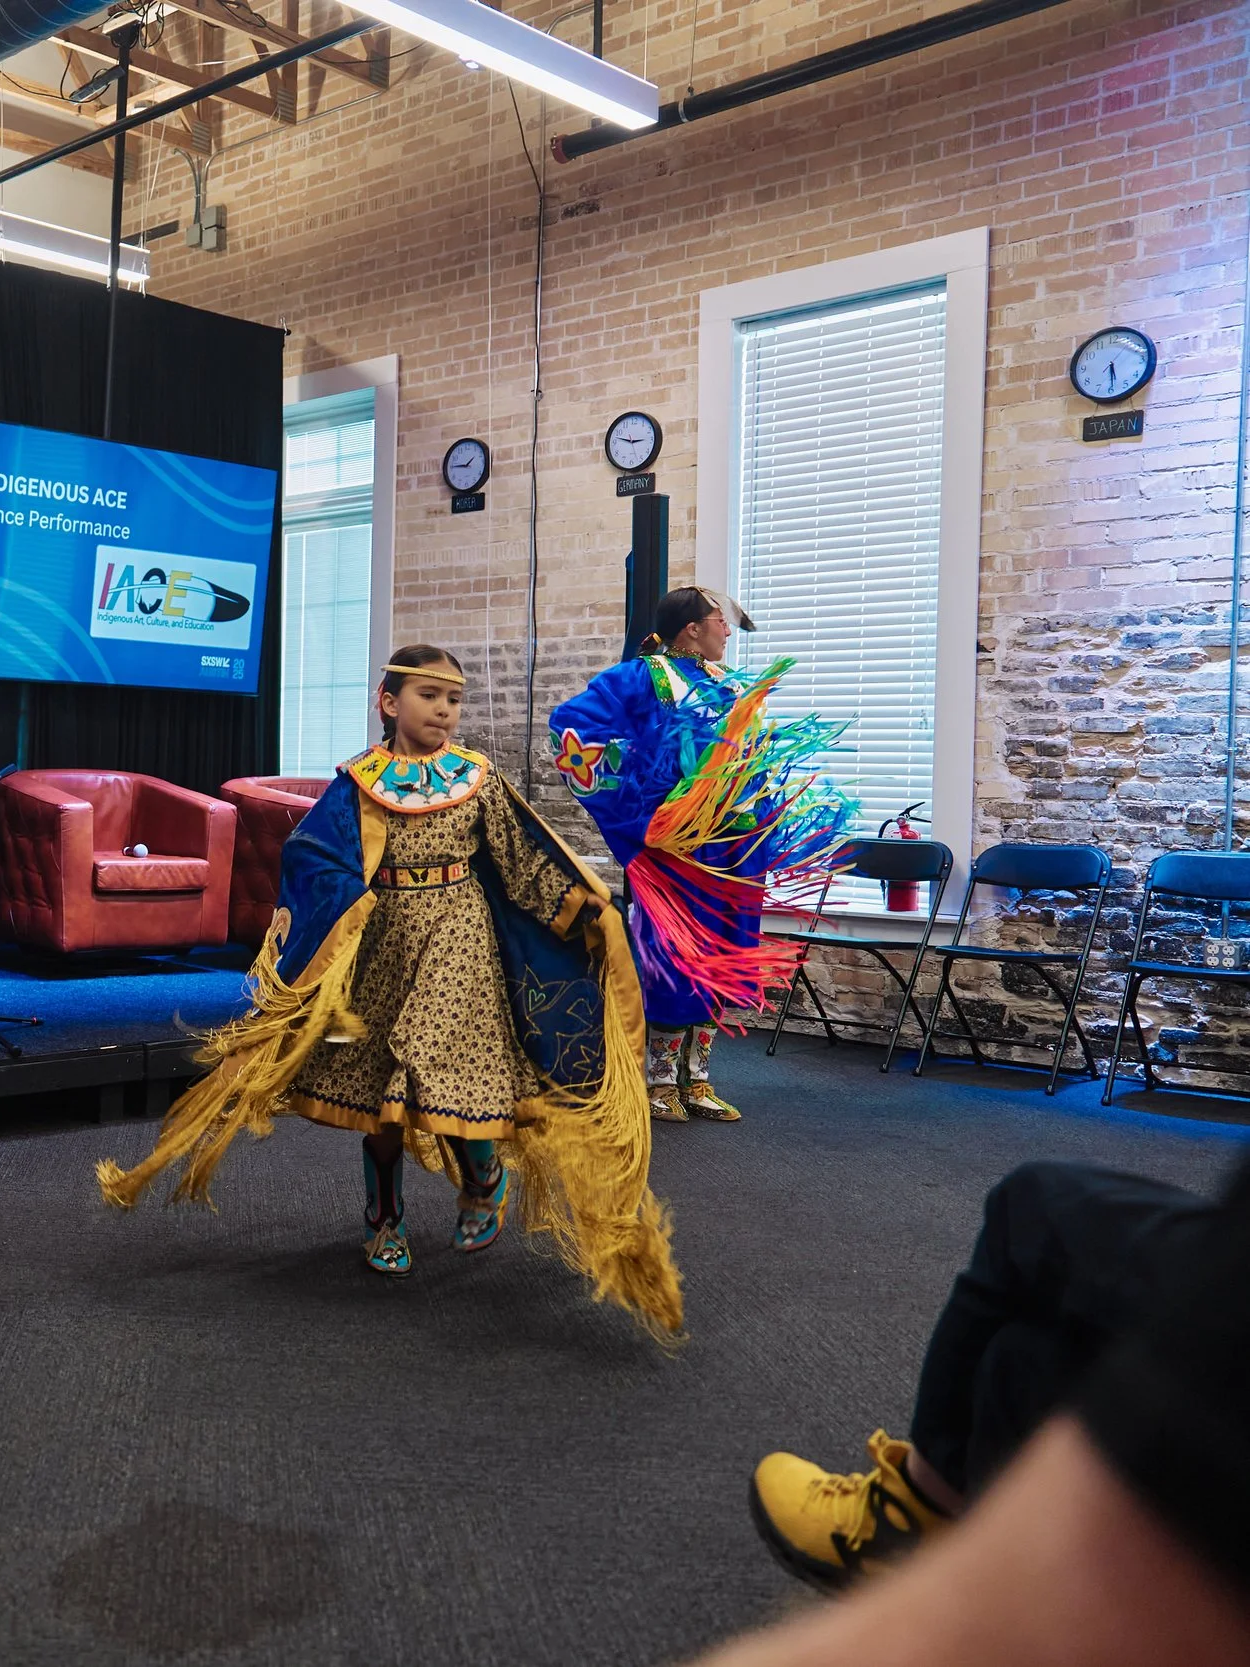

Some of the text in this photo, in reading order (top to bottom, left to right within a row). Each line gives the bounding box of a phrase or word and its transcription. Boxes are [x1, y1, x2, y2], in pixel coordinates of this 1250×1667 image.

[1096, 341, 1104, 350] 11
[1085, 351, 1096, 360] 10
[1089, 417, 1137, 435] JAPAN
[617, 477, 650, 493] GERMANY
[92, 488, 128, 510] ACE
[29, 510, 131, 540] Performance
[98, 563, 193, 617] IACE
[97, 612, 133, 624] Indigenous
[146, 616, 170, 628] Culture,
[171, 619, 183, 629] and
[184, 620, 215, 631] Education
